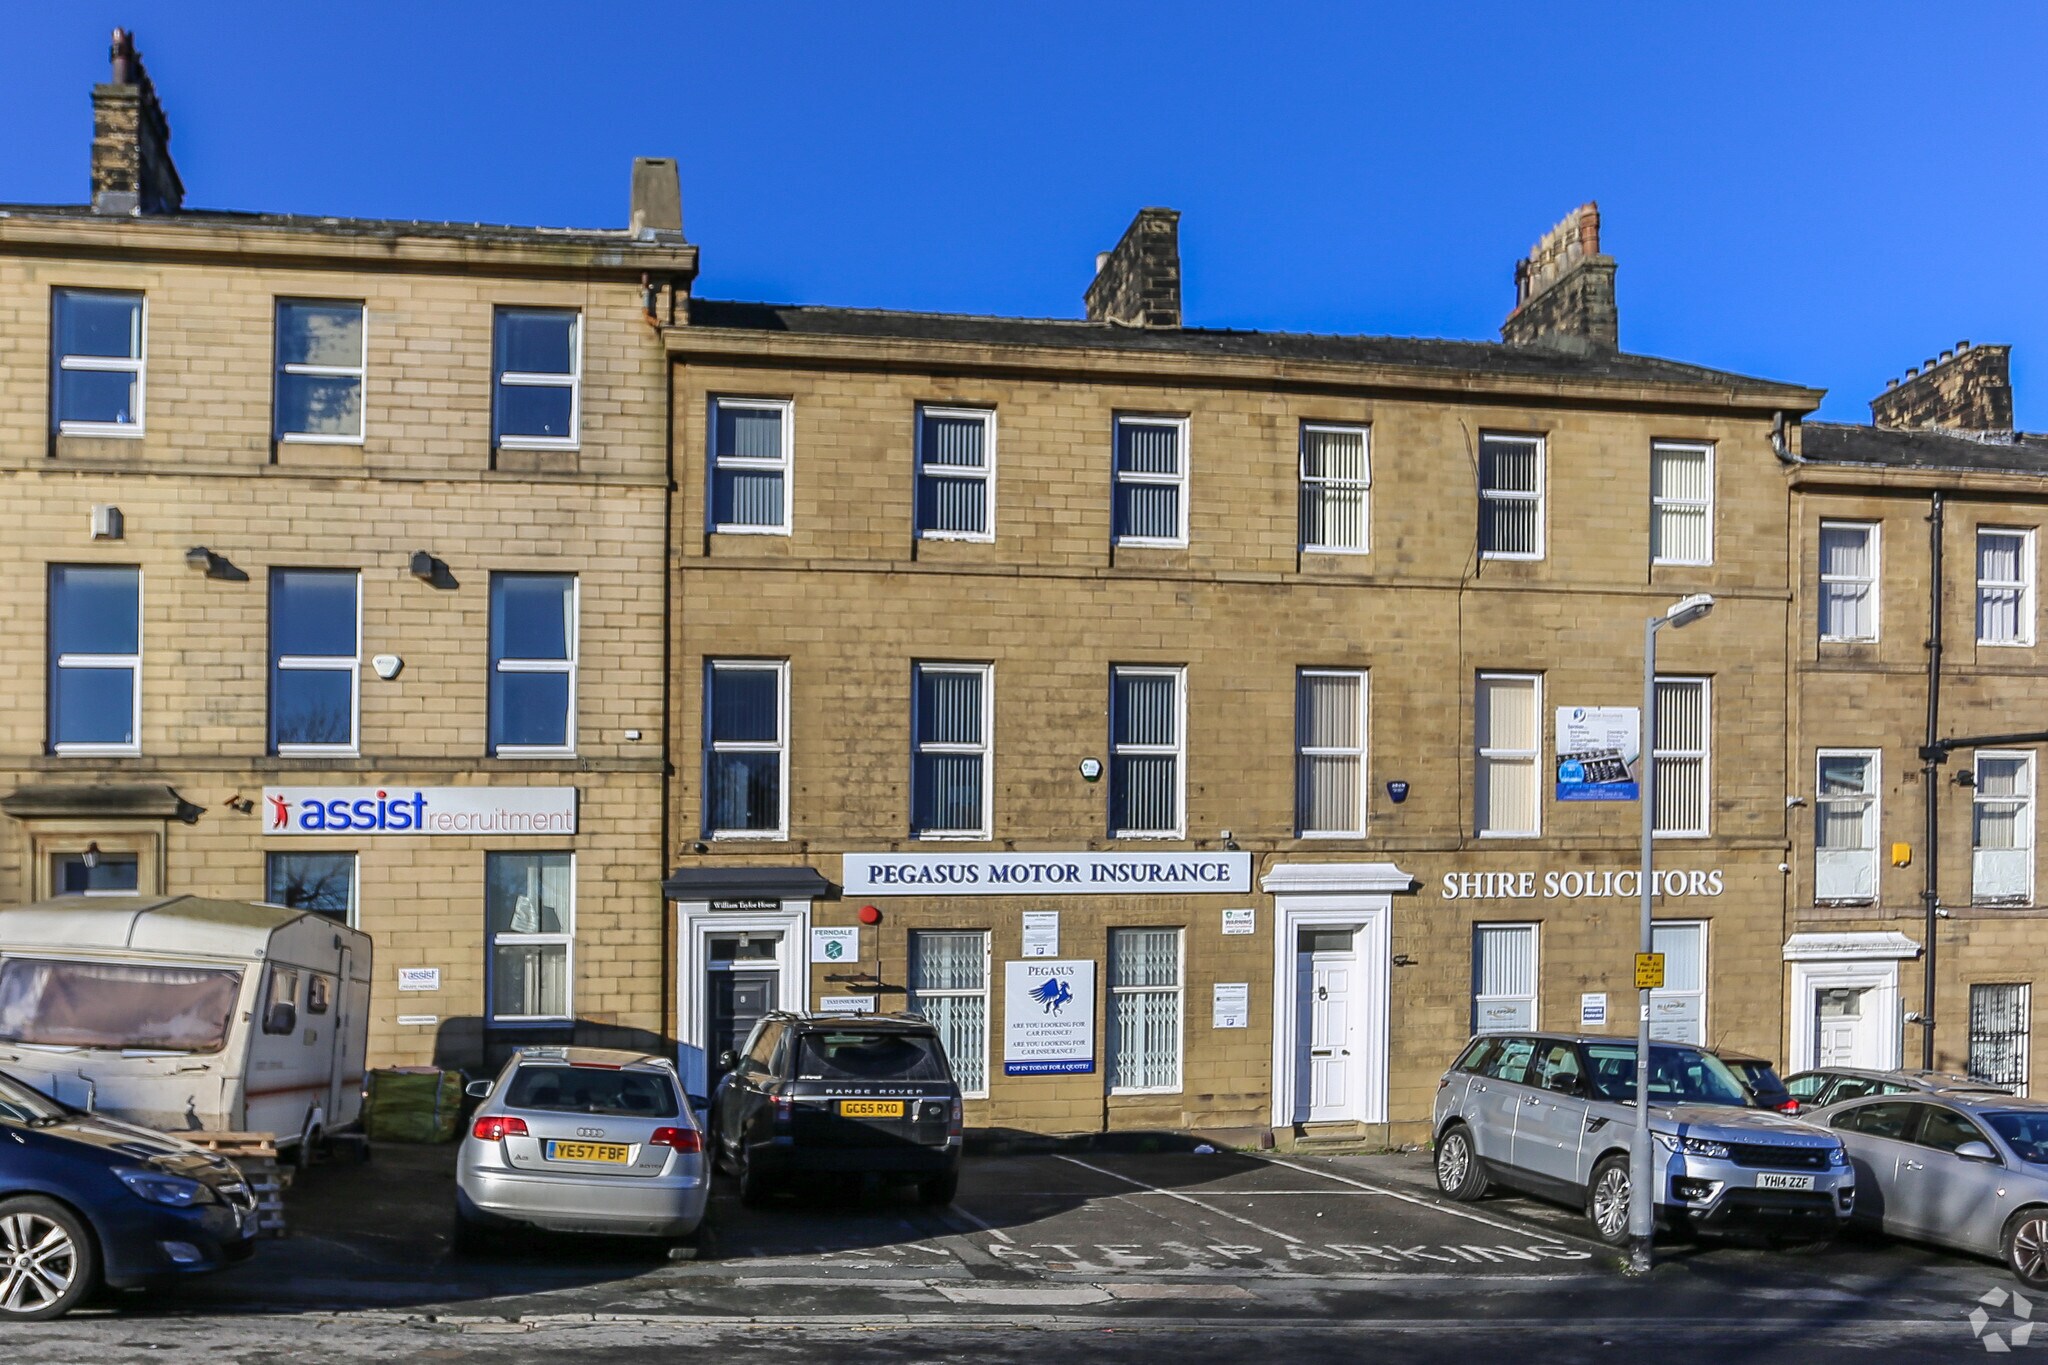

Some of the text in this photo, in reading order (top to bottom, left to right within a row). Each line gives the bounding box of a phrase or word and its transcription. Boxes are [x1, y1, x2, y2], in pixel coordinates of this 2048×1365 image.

[300, 790, 572, 831] assist recruitment
[867, 863, 1230, 883] PEGASUS MOTOR INSURANCE
[1442, 871, 1537, 899] SHIRE
[757, 901, 777, 909] House
[1028, 966, 1074, 976] PEGASUS
[846, 1103, 874, 1114] GC65
[557, 1143, 626, 1161] YE57 FBF
[1764, 1175, 1809, 1189] YH14 ZZF
